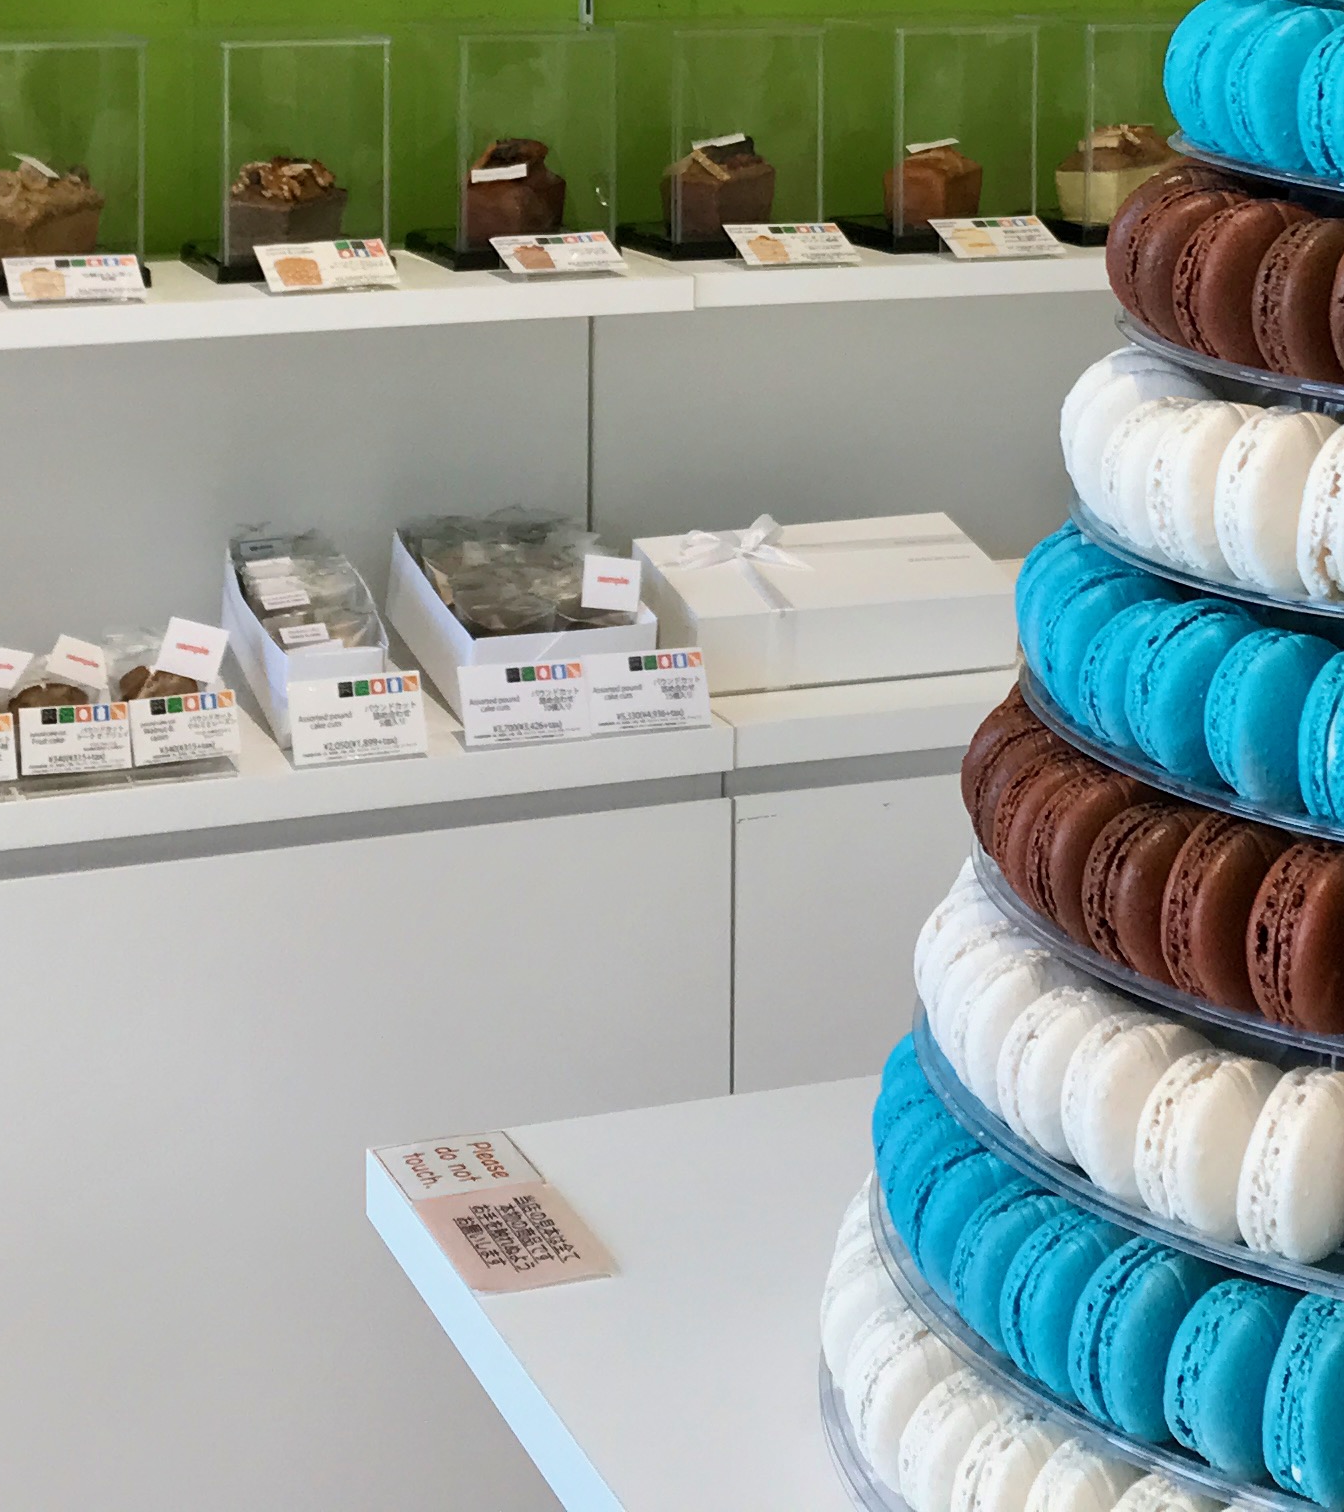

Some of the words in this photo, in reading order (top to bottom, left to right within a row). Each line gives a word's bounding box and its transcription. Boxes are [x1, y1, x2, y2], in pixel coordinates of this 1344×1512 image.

[596, 576, 631, 586] sample
[402, 1152, 443, 1190] touch.
[434, 1146, 460, 1161] do
[448, 1162, 482, 1182] not
[455, 1216, 507, 1268] お願いします
[498, 1202, 556, 1262] 本物の商品です
[513, 1194, 582, 1262] 当店の見本は全て
